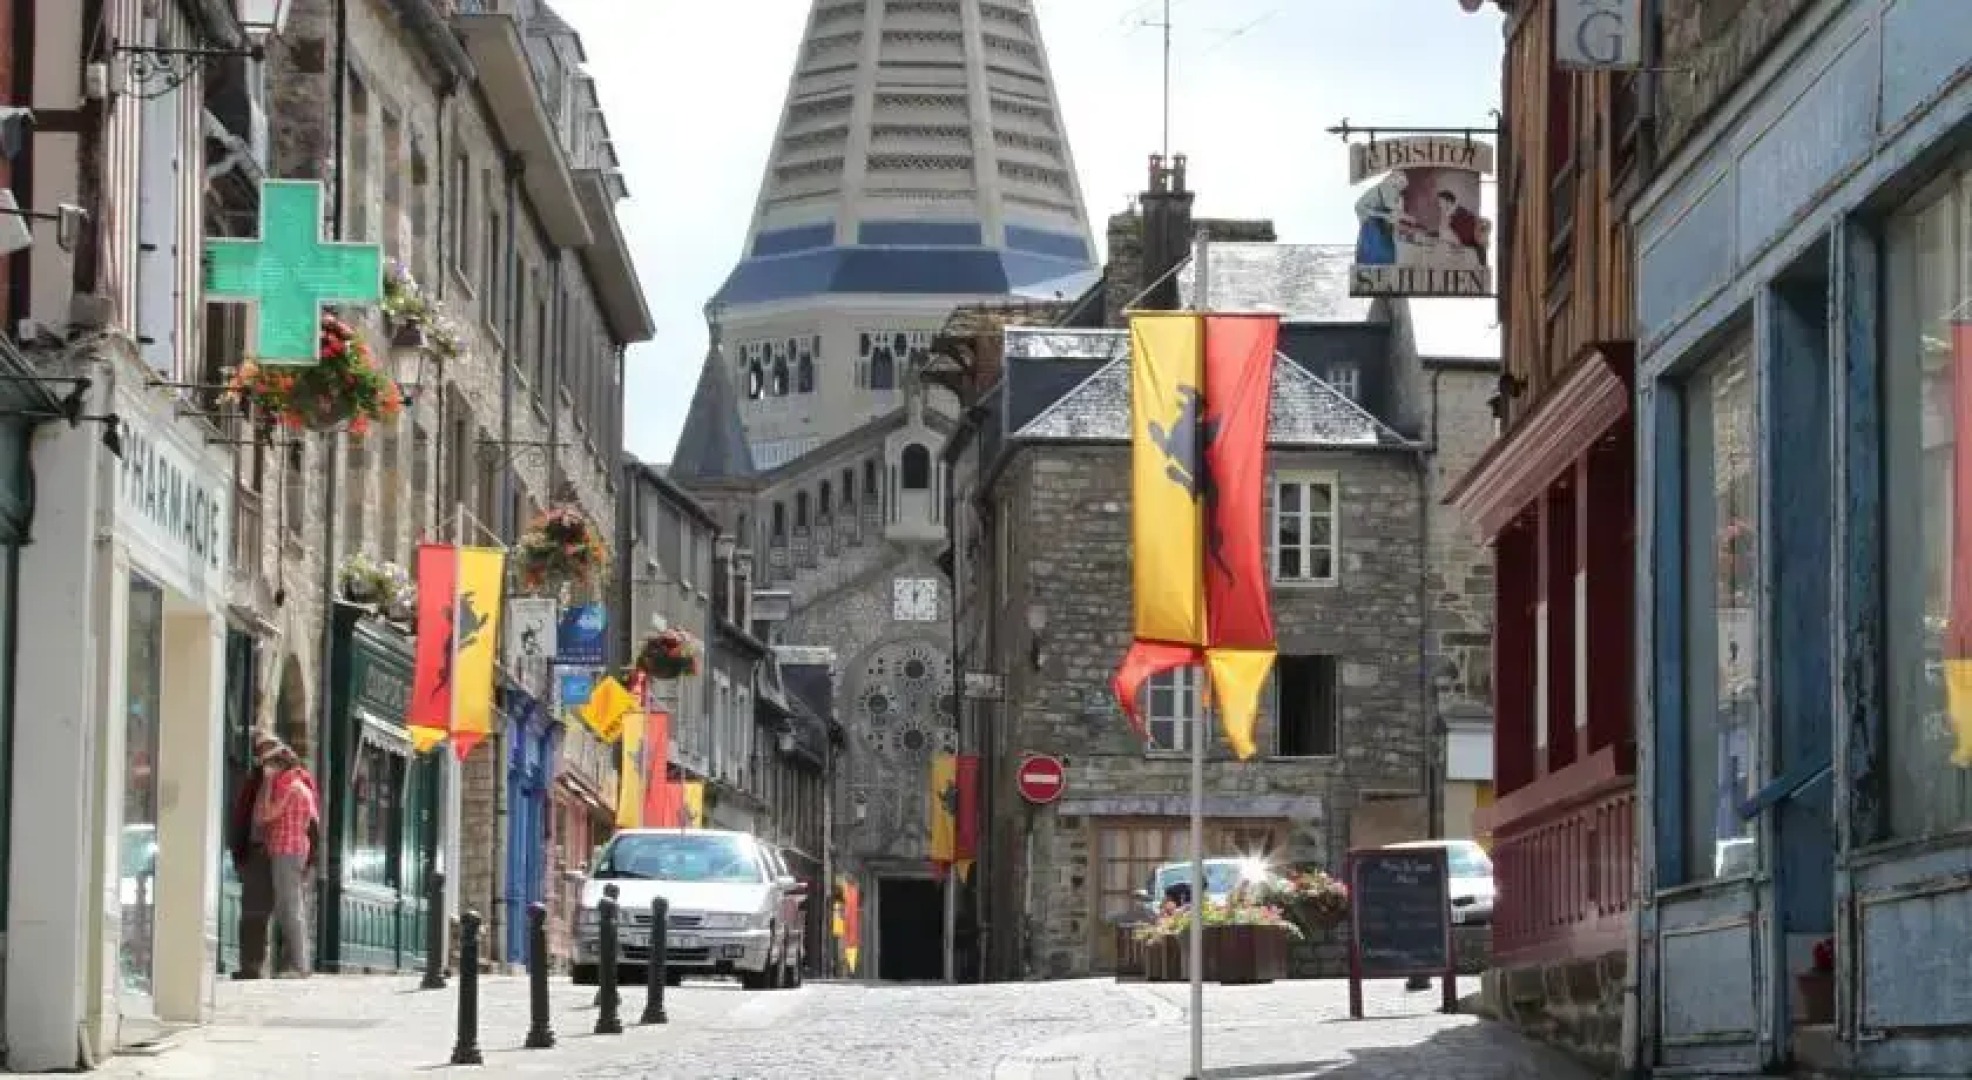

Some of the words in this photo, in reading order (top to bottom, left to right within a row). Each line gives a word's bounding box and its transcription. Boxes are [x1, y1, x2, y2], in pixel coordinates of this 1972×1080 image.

[1577, 0, 1623, 64] G
[1391, 268, 1485, 293] JULIEN
[120, 421, 219, 569] PHARMACIE
